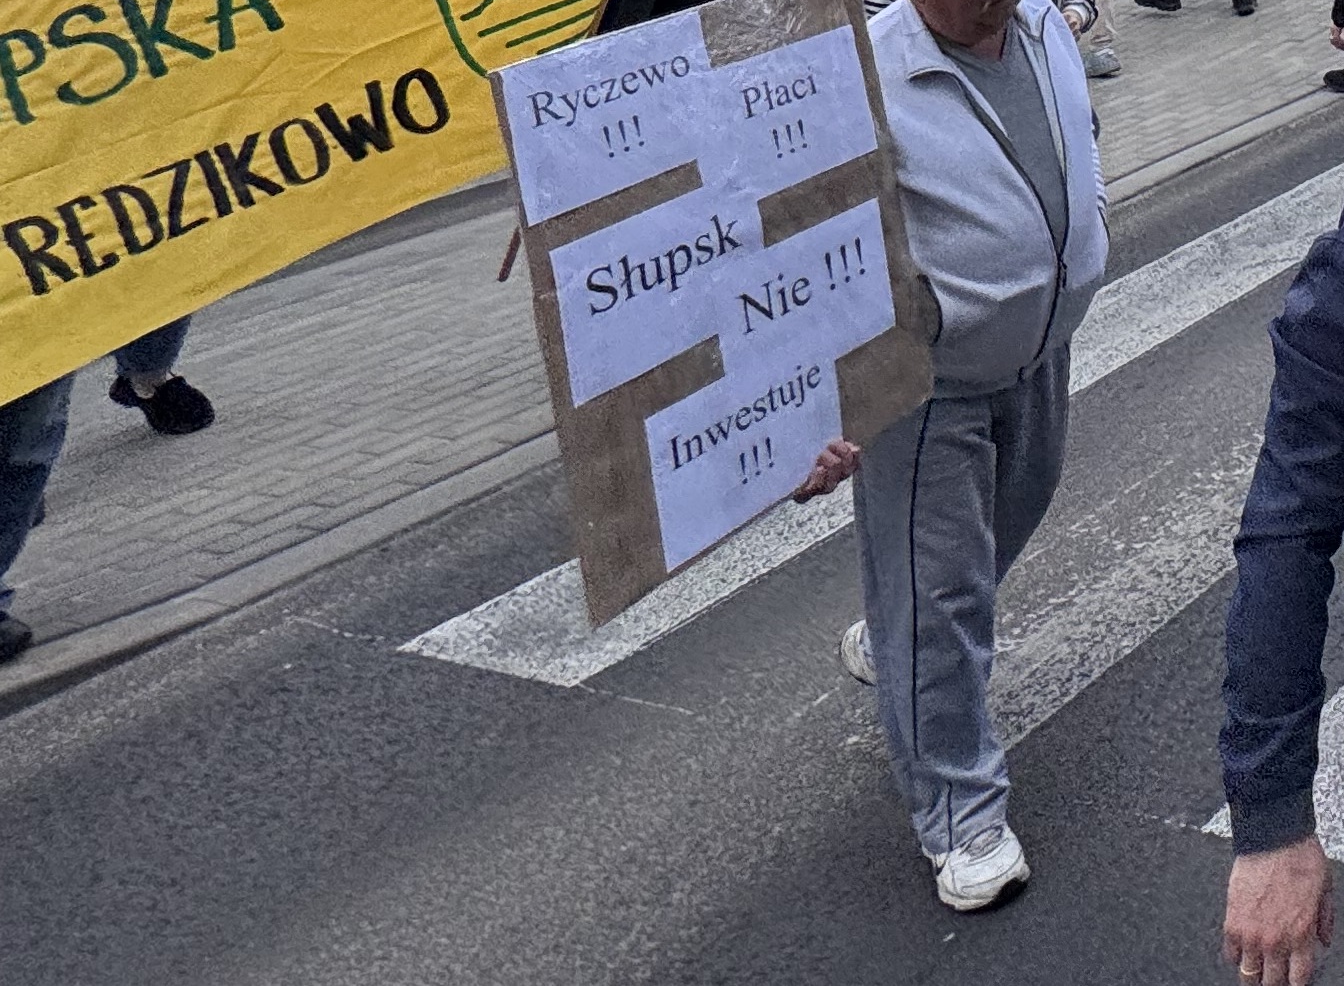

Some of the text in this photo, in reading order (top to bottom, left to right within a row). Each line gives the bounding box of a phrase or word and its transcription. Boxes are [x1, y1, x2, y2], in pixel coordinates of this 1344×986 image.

[527, 54, 690, 129] Ryczewo
[740, 67, 819, 119] Płaci
[602, 115, 645, 158] !!!
[771, 118, 809, 159] !!!
[2, 67, 452, 295] REDZIKOWO
[586, 214, 744, 316] Słupsk
[739, 236, 867, 335] Nie !!!
[668, 363, 822, 472] Inwestuje
[738, 436, 776, 485] !!!
